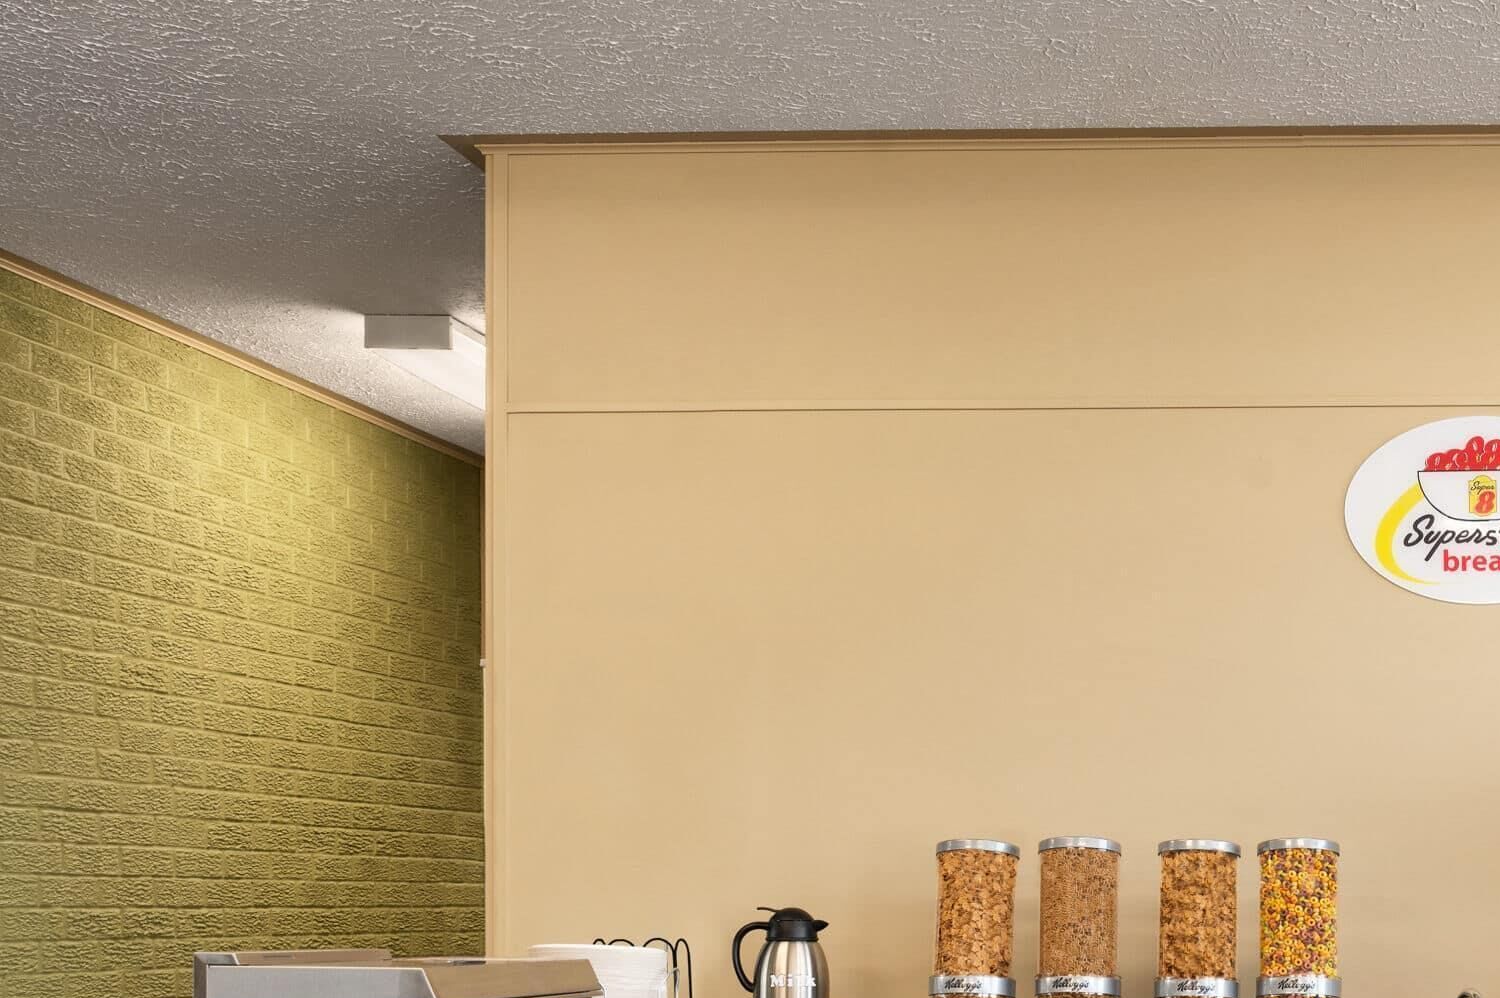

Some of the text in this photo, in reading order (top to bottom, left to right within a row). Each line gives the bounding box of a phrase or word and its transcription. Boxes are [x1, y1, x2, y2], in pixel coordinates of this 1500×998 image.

[1470, 480, 1495, 495] Super
[1475, 490, 1496, 514] 8
[770, 974, 817, 988] Milk
[944, 977, 983, 992] Kellogg's
[1052, 977, 1089, 992] Kellogg's
[1176, 980, 1215, 994] Kellogg's
[1277, 978, 1316, 992] Kellogg's
